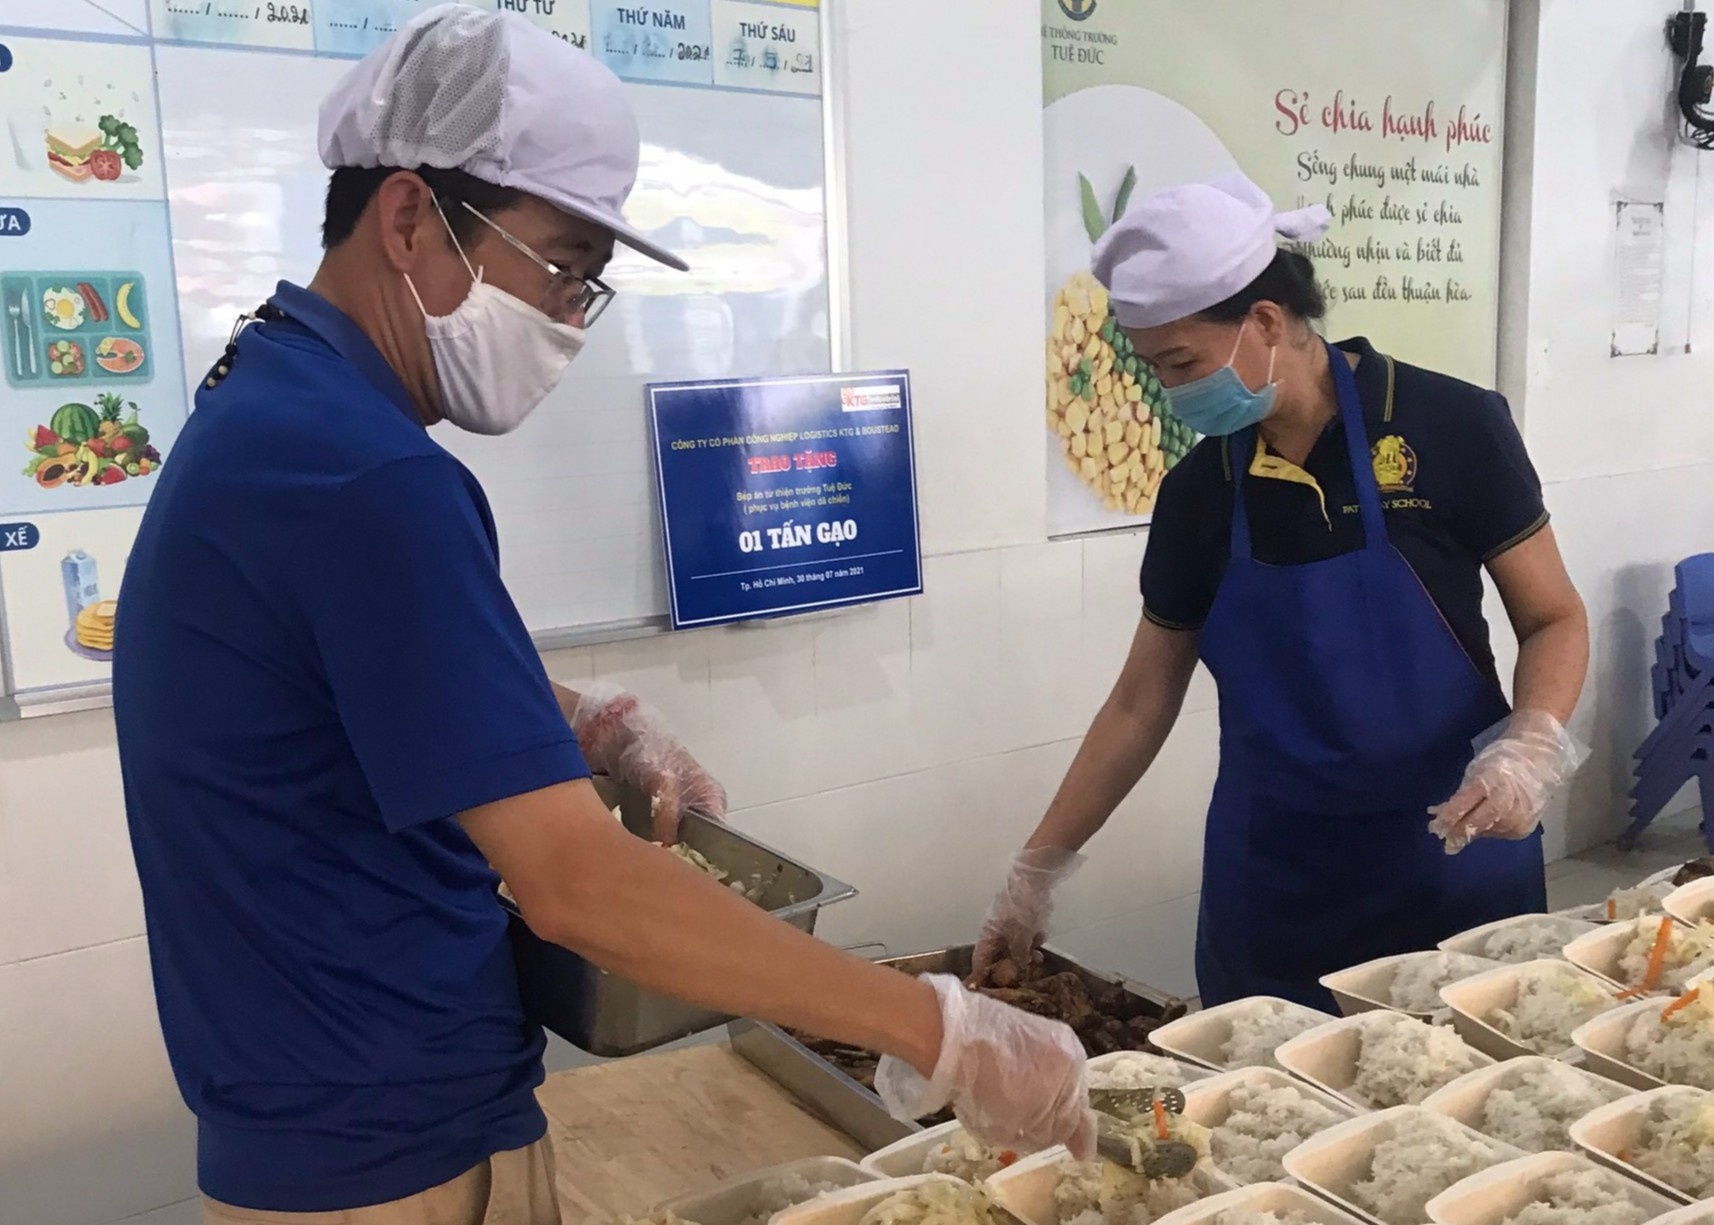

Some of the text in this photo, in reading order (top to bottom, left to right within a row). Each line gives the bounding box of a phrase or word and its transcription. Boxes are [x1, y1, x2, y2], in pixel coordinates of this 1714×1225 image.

[617, 6, 686, 30] THỨ NĂM
[739, 21, 796, 42] THỨ SÁU
[1051, 43, 1104, 66] TUỆ ĐỨC
[1275, 88, 1492, 153] Sẻ chia hạnh phúc
[1297, 149, 1480, 188] Sống chung một mái nhà
[1341, 195, 1374, 227] phúc
[1380, 195, 1410, 225] được
[1433, 200, 1463, 226] chia
[1356, 235, 1391, 264] nhịn
[1396, 242, 1412, 261] và
[1416, 236, 1442, 264] biết
[1446, 238, 1464, 263] đủ
[1342, 286, 1367, 303] sau
[1372, 275, 1397, 300] đều
[1402, 275, 1441, 304] thuận
[671, 439, 696, 450] CÔNG
[697, 439, 708, 448] TY
[746, 433, 768, 445] CÔNG
[800, 428, 838, 441] LOGISTICS
[839, 427, 854, 437] KTG
[855, 426, 861, 436] &
[862, 424, 900, 436] BOUSTEAD
[747, 449, 837, 475] TRAO TẶNG
[775, 486, 794, 498] thiện
[795, 484, 821, 496] trường
[822, 482, 836, 493] Tuệ
[837, 480, 852, 491] Đức
[769, 502, 779, 512] vụ
[780, 499, 799, 511] bệnh
[801, 497, 816, 508] viện
[1391, 498, 1432, 510] SCHOOL
[5, 525, 28, 547] XẾ
[739, 519, 858, 553] 01 TẤN GẠO
[740, 566, 864, 592] Tp. Hồ Chí Minh, 30 tháng 07 năm 2021
